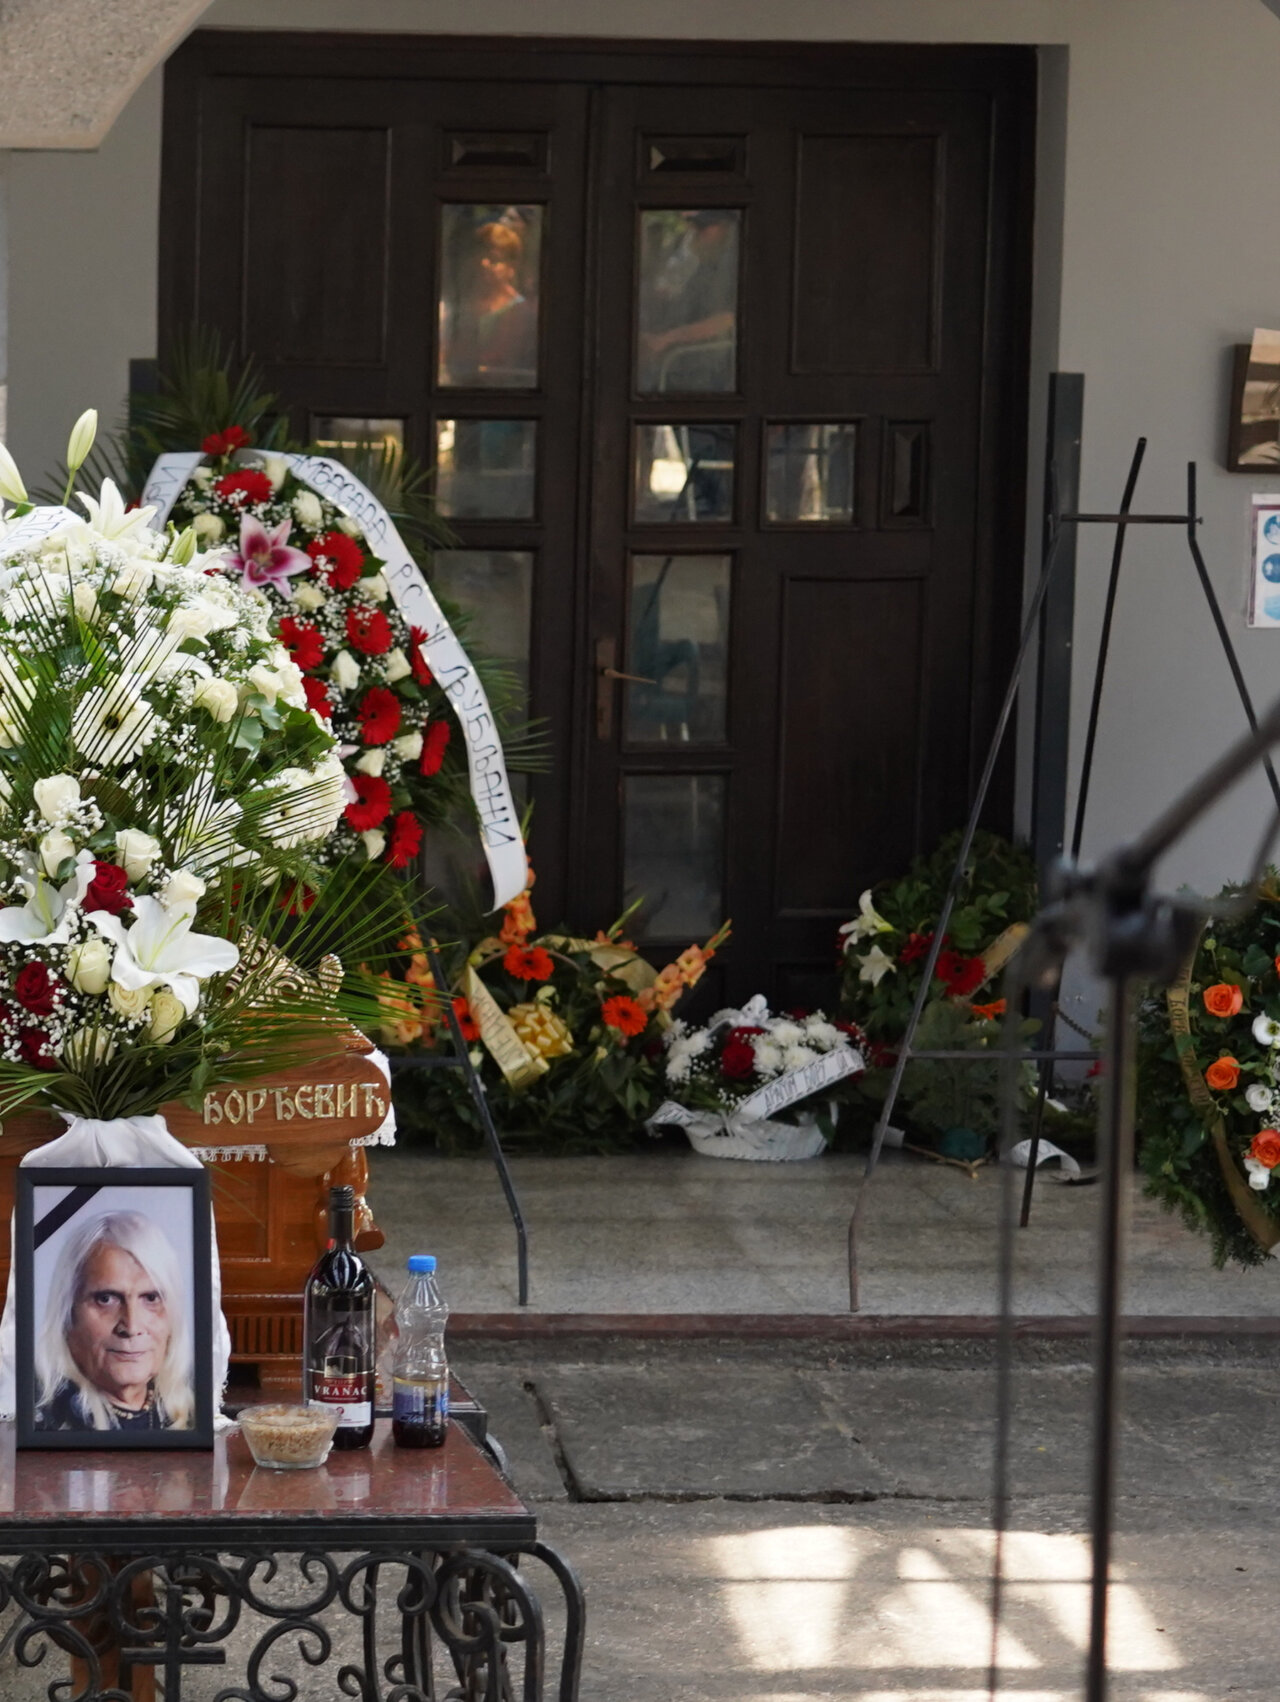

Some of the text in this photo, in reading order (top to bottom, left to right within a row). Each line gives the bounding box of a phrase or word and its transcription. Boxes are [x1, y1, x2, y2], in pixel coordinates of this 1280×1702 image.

[289, 454, 386, 545] АМБАСАДА
[424, 622, 447, 647] У
[438, 666, 516, 849] ЉУБЉАНИ
[203, 1082, 386, 1125] ЂОРЂЕВИЋ
[314, 1384, 368, 1396] VRANAC
